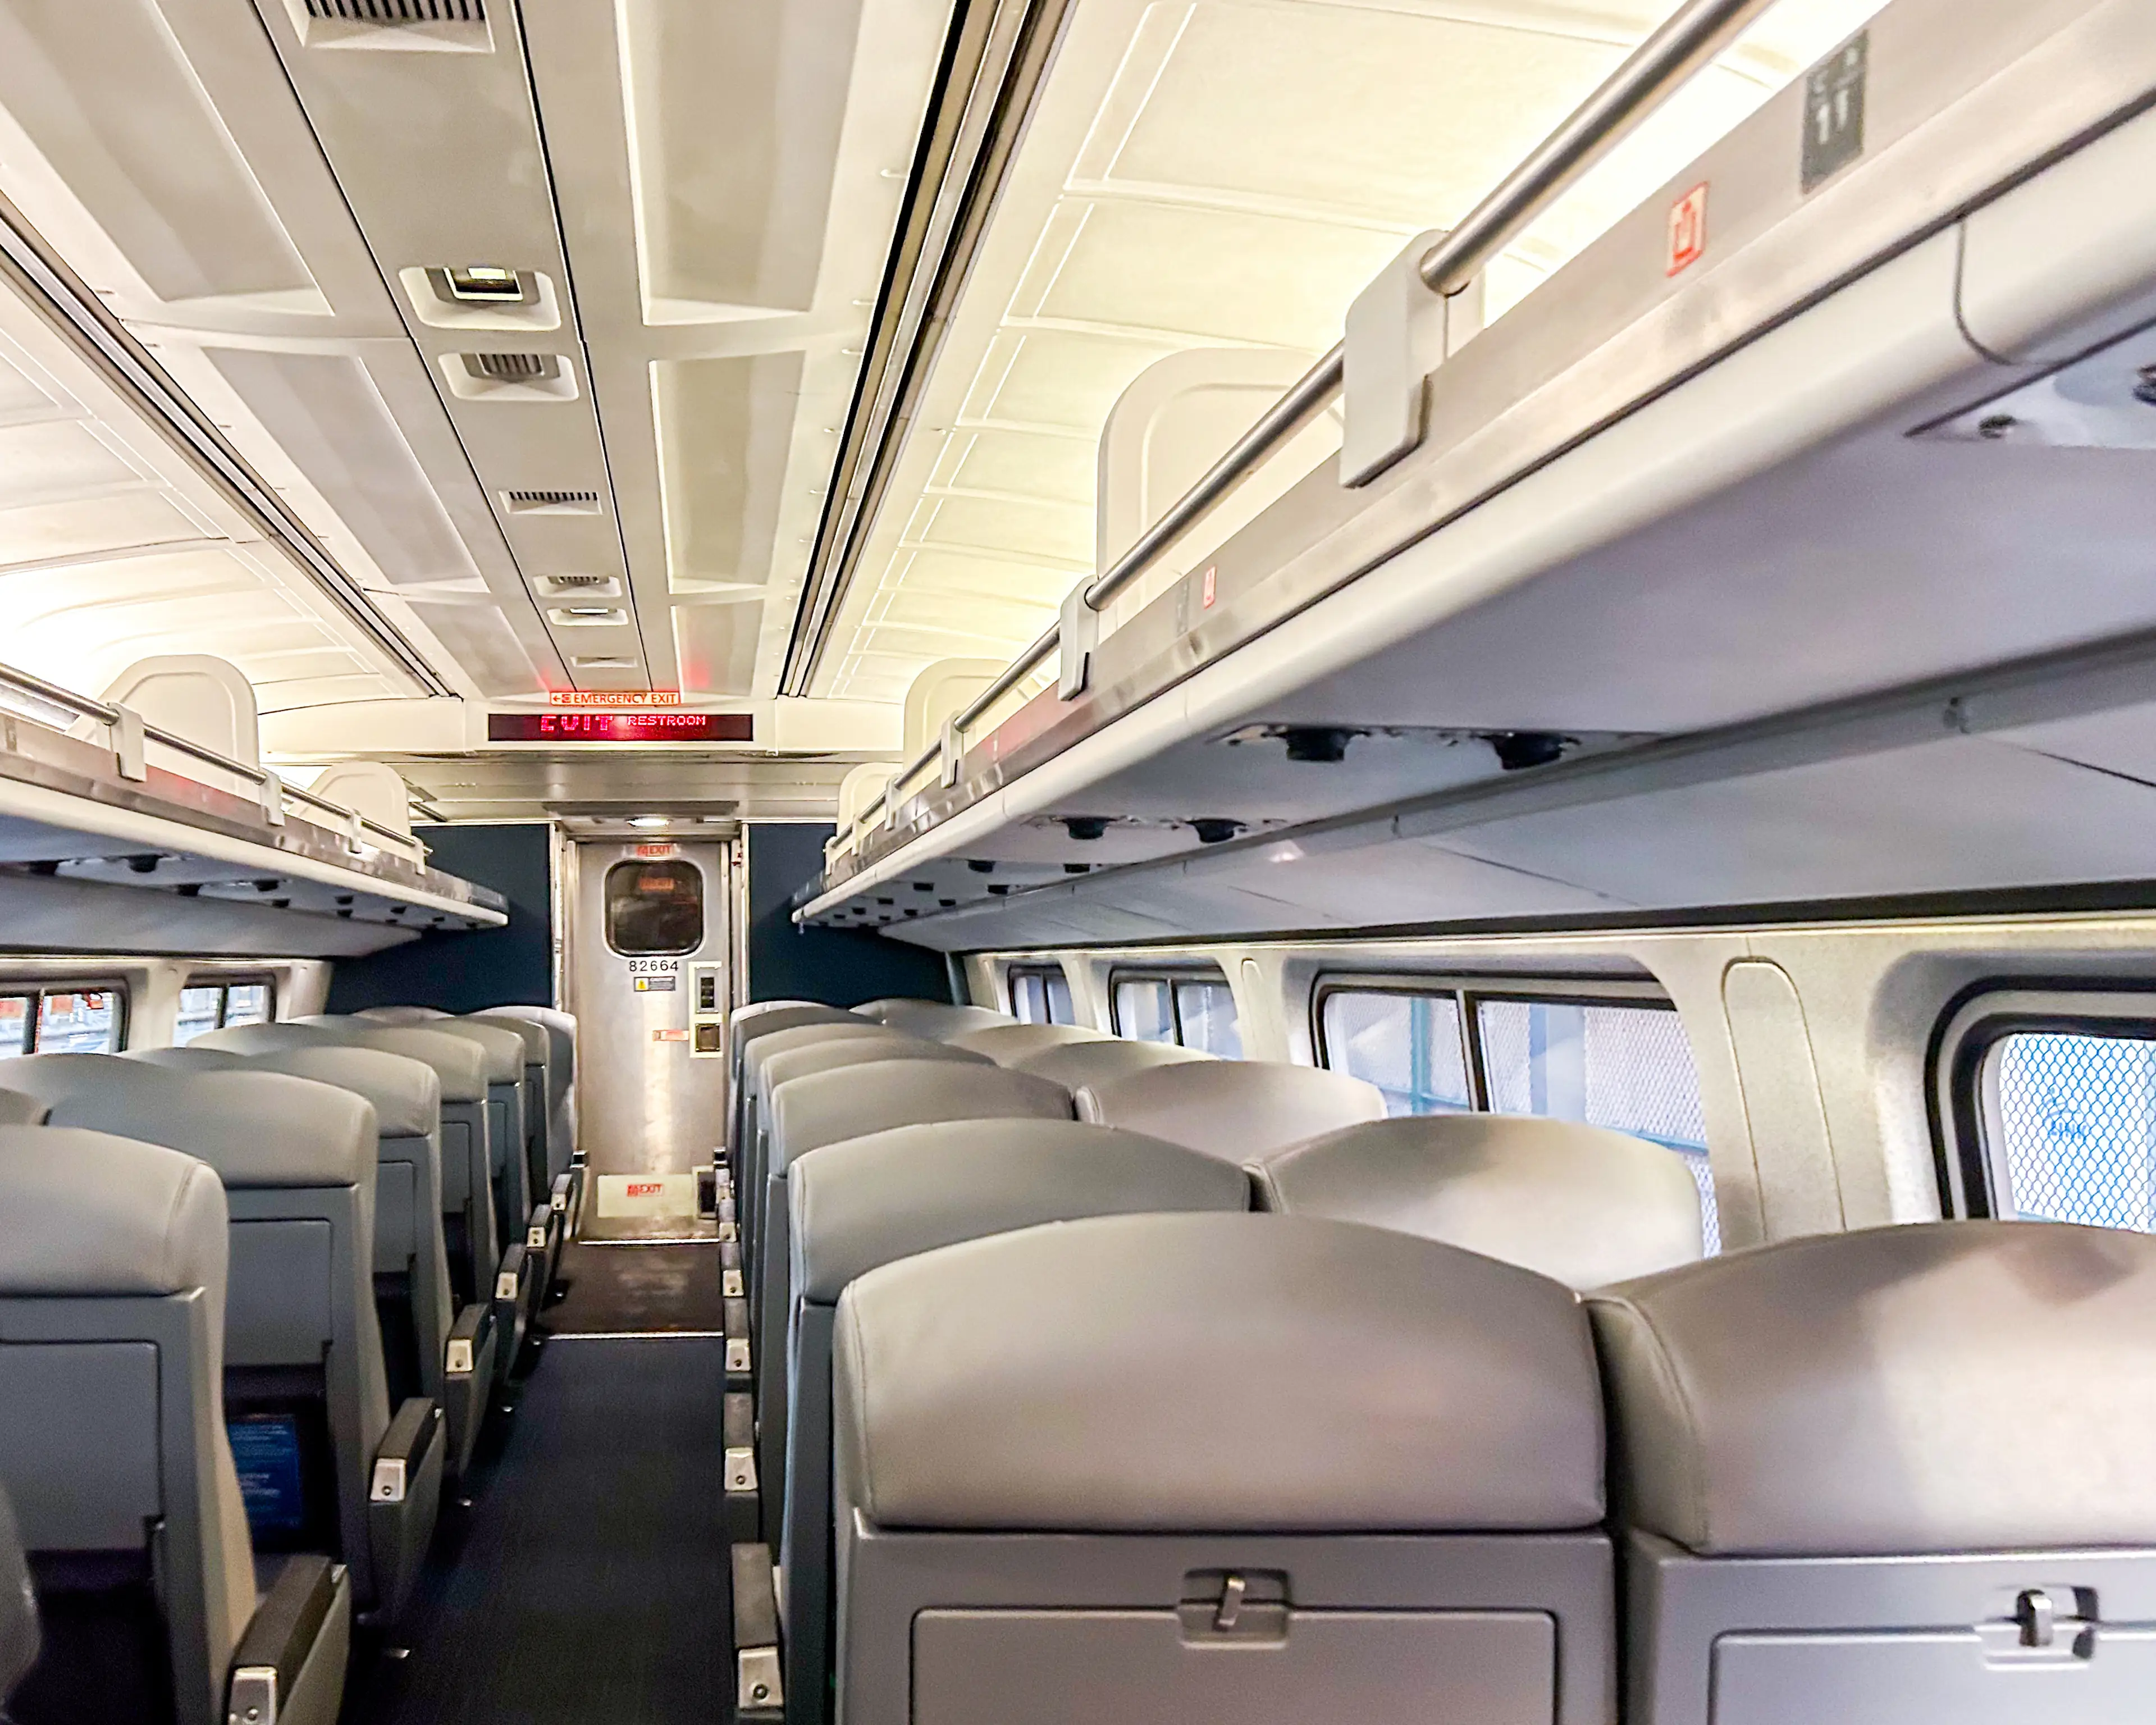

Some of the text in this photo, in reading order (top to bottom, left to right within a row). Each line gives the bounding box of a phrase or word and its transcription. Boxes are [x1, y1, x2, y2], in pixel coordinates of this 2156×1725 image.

[574, 694, 677, 704] EMERGENCY EXIT
[627, 715, 706, 726] RESTROOM
[650, 845, 671, 855] EXIT
[629, 960, 679, 971] 82664
[640, 1184, 661, 1193] EXIT
